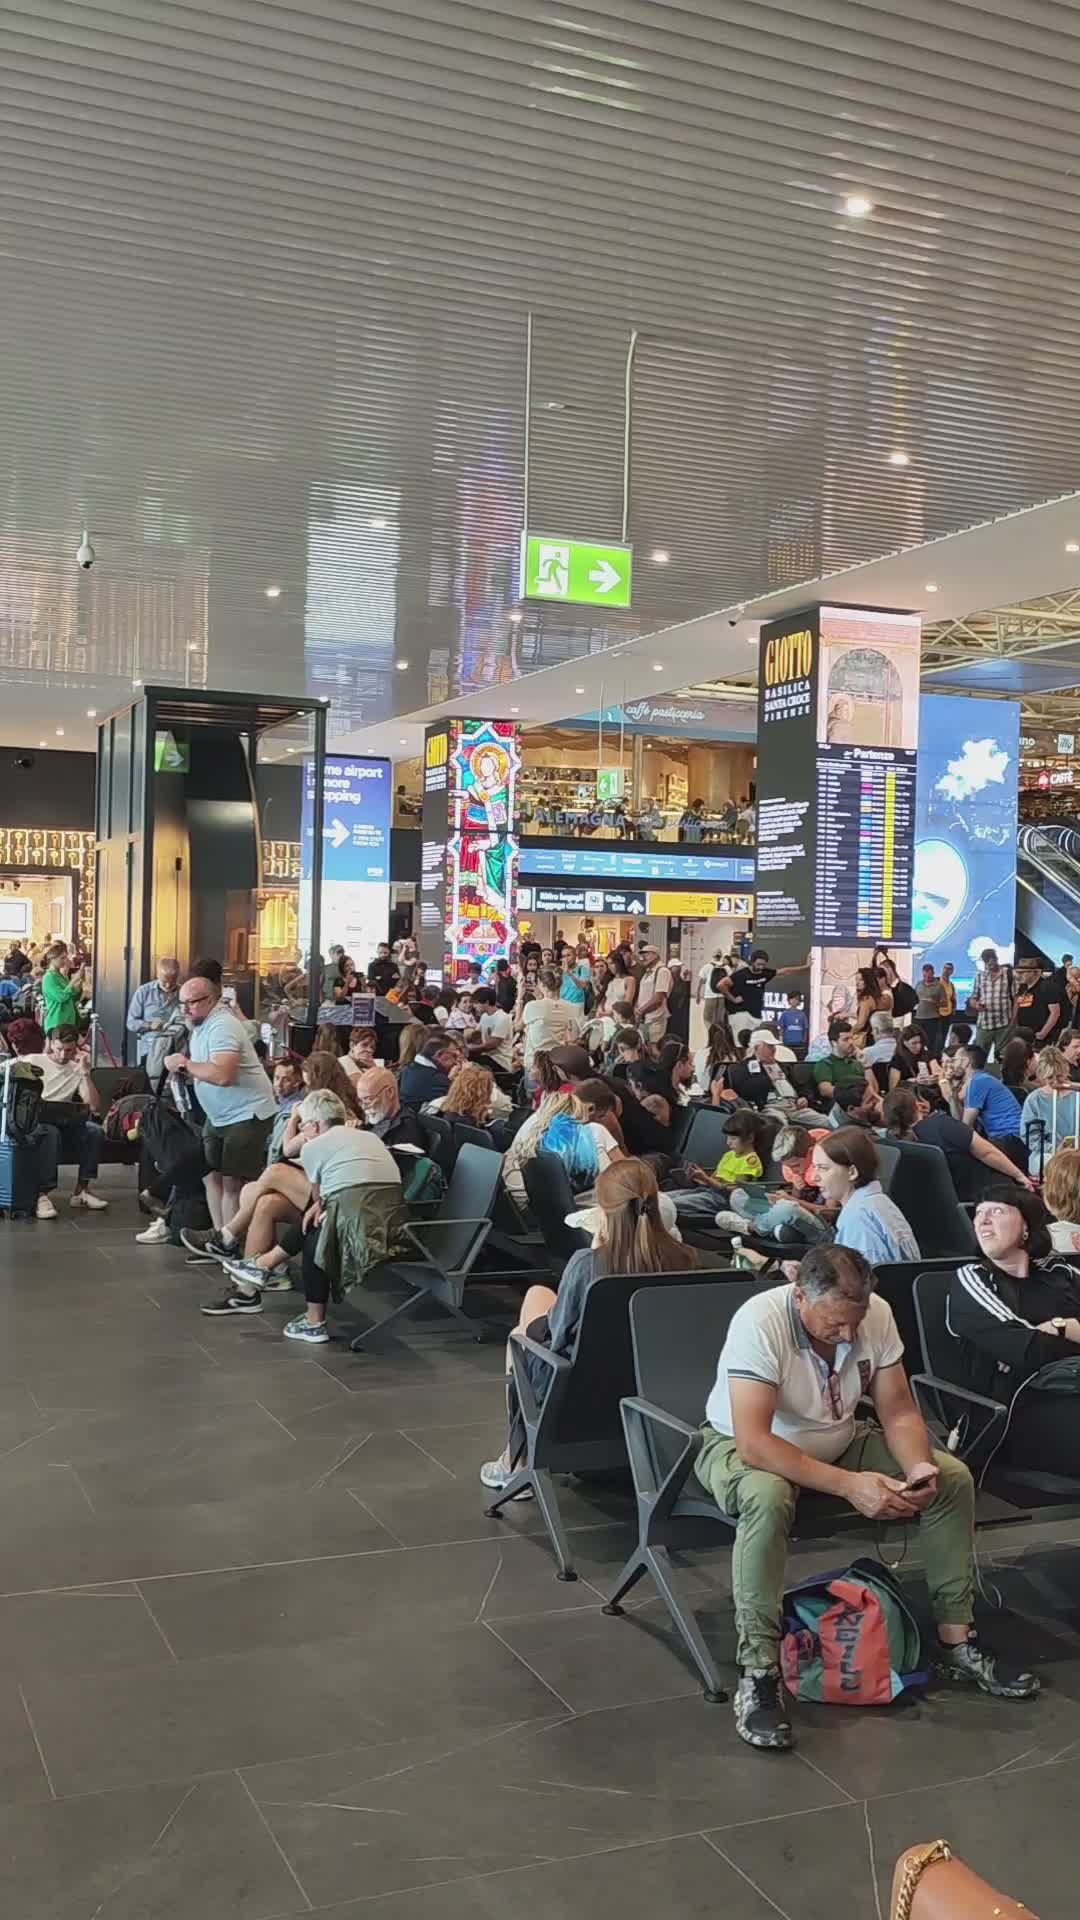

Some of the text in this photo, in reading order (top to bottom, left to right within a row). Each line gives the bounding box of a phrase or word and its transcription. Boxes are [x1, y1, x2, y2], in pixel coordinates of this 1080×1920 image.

[765, 630, 812, 686] GIOTTO
[765, 680, 811, 699] BASILICA
[764, 705, 811, 723] FIRENZE
[343, 764, 384, 780] airport
[306, 789, 361, 805] spping
[533, 808, 625, 827] ALEMAGNA
